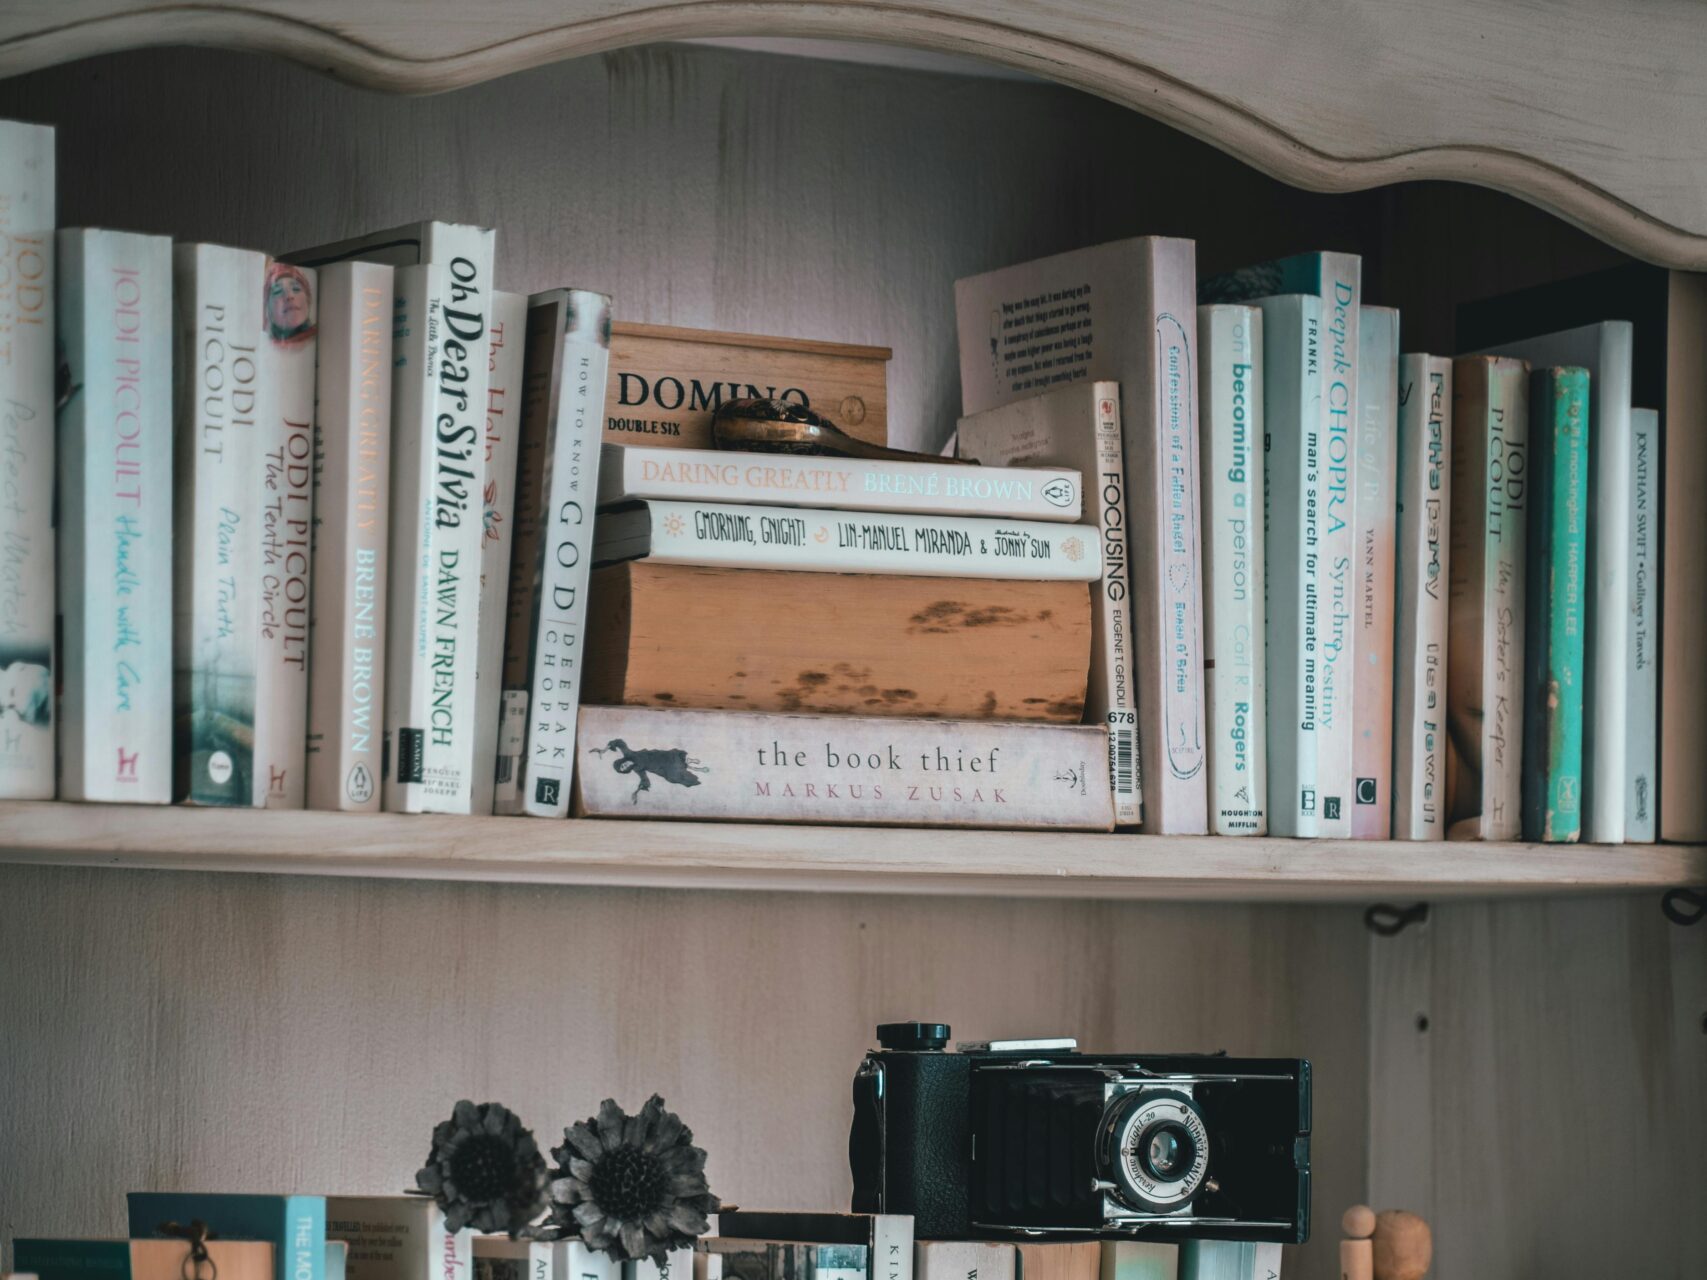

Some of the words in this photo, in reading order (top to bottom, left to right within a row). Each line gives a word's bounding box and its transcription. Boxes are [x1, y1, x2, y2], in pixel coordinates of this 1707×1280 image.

[112, 267, 142, 345] JODI
[449, 257, 478, 304] Oh
[440, 305, 484, 411] Dear
[1307, 318, 1318, 377] FRANKL
[1328, 281, 1354, 375] Deepak
[203, 305, 226, 464] PICOULT
[229, 344, 256, 428] JODI
[577, 357, 590, 397] HOW
[115, 358, 142, 508] PICOULT
[574, 408, 585, 429] TO
[283, 418, 312, 503] JODI
[434, 413, 479, 530] Silvia
[568, 439, 583, 493] KNOW
[1327, 380, 1349, 536] CHOPRA
[1489, 407, 1504, 544] PICOULT
[1506, 440, 1525, 512] JODI
[1635, 432, 1648, 509] JONATHAN
[838, 521, 910, 553] LIN-MANUEL
[914, 527, 973, 556] MIRANDA
[978, 540, 987, 556] &
[993, 536, 1027, 560] JONNY
[1028, 540, 1050, 562] SUN
[1305, 488, 1320, 547] search
[1365, 528, 1376, 567] YANN
[1635, 513, 1647, 558] SWIFT
[435, 550, 460, 629] DAWN
[552, 501, 584, 610] GOD
[1305, 552, 1318, 578] for
[283, 518, 308, 673] PICOULT
[1304, 583, 1318, 652] ultimate
[1329, 556, 1350, 653] Synchro
[1364, 572, 1375, 630] MARTEL
[1634, 569, 1647, 627] Gulliver's
[1495, 607, 1513, 682] Sister's
[1635, 629, 1646, 671] Travels
[431, 636, 456, 747] FRENCH
[535, 630, 558, 756] CHOPRA
[551, 633, 576, 759] DEEPAK
[1107, 713, 1135, 725] 678
[1301, 658, 1317, 732] meaning
[1318, 641, 1339, 730] Destiny
[758, 741, 808, 768] the
[826, 744, 903, 770] book
[921, 748, 1002, 774] thief
[1489, 694, 1509, 769] Keeper
[756, 781, 884, 800] MARKUS
[907, 785, 1009, 804] ZUSAK
[1221, 809, 1263, 817] HOUGHTON
[1228, 821, 1258, 829] MIFFLIN
[295, 1216, 313, 1249] THE
